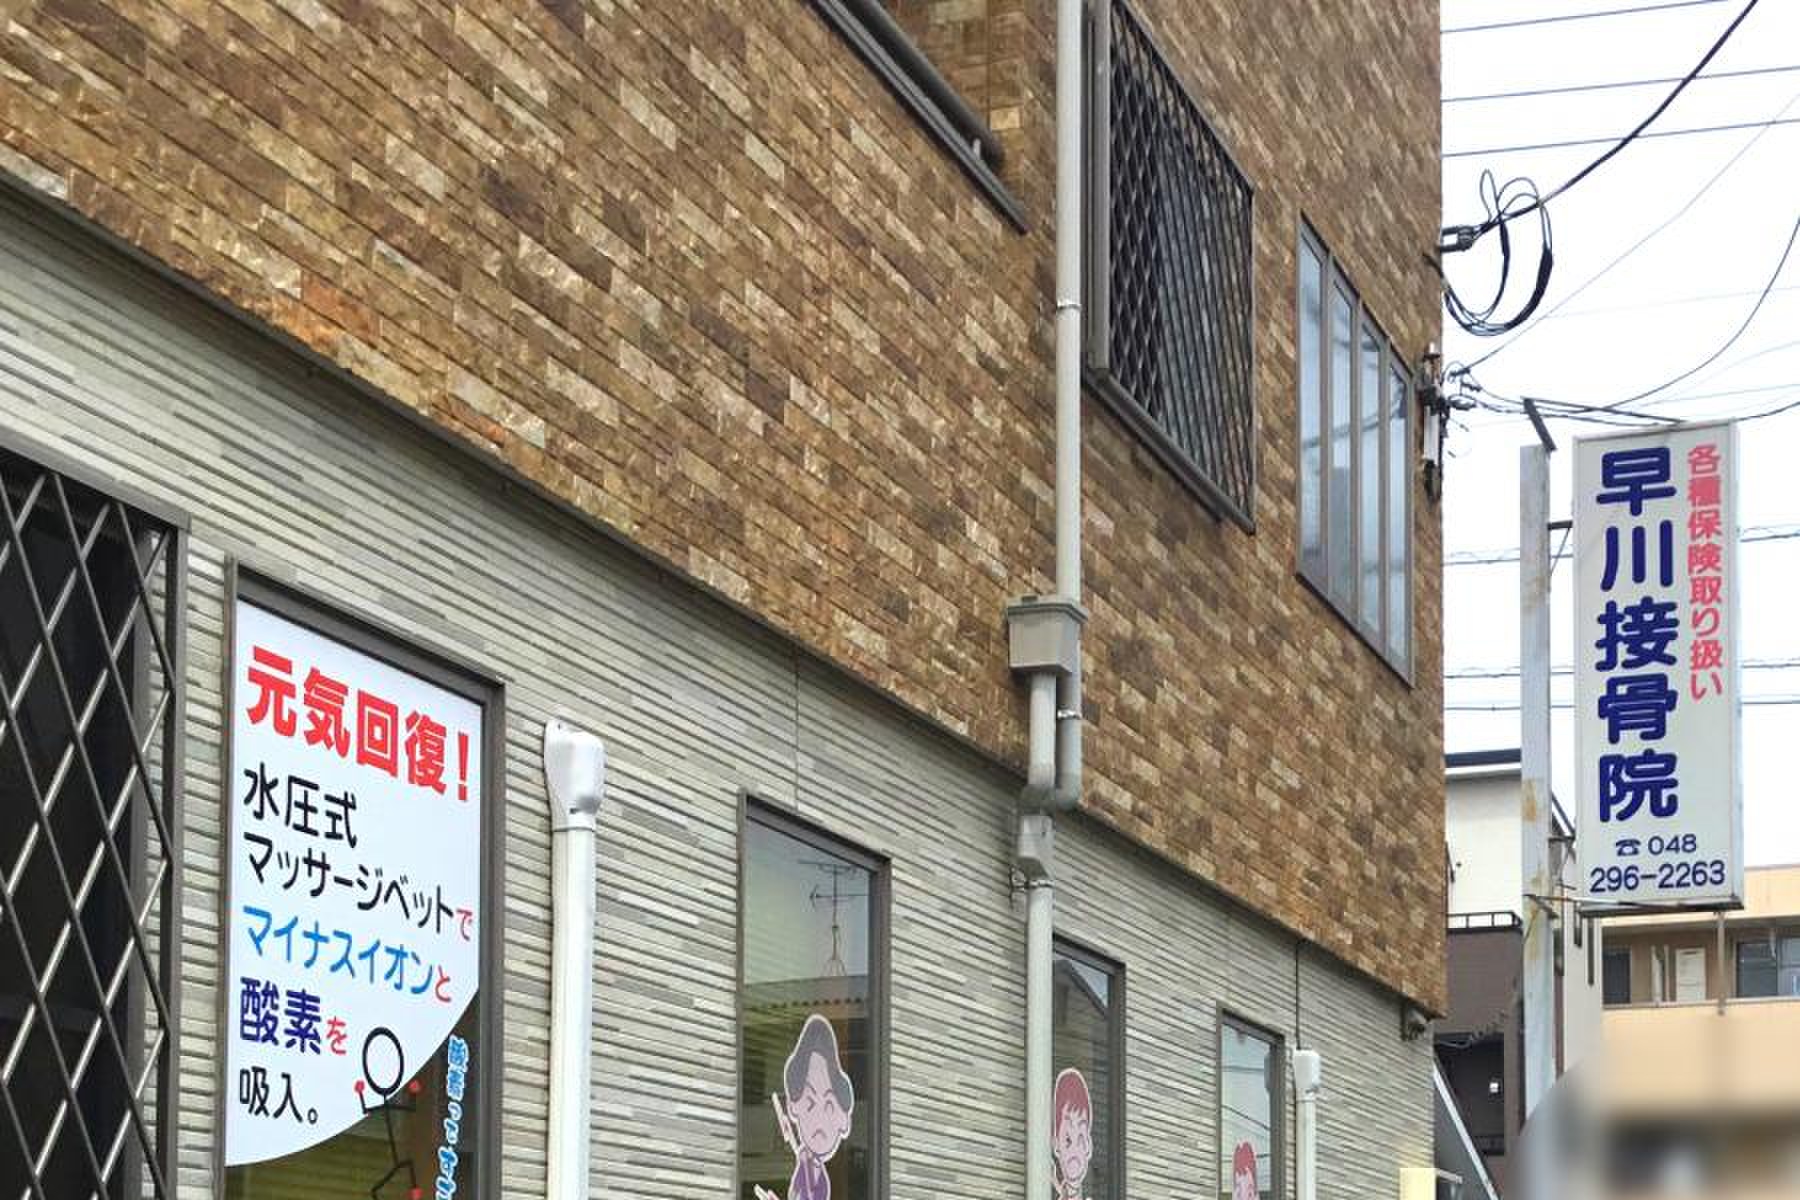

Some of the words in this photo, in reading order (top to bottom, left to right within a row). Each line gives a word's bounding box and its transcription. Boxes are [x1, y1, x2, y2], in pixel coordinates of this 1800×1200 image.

[1595, 446, 1681, 823] 早川接骨院
[243, 761, 357, 848] 水圧式
[1589, 860, 1726, 893] 296-2263
[1647, 834, 1698, 857] 048
[243, 904, 452, 1004] マイナスイオンと
[240, 976, 348, 1055] 酸素を
[240, 1065, 319, 1125] 吸入。
